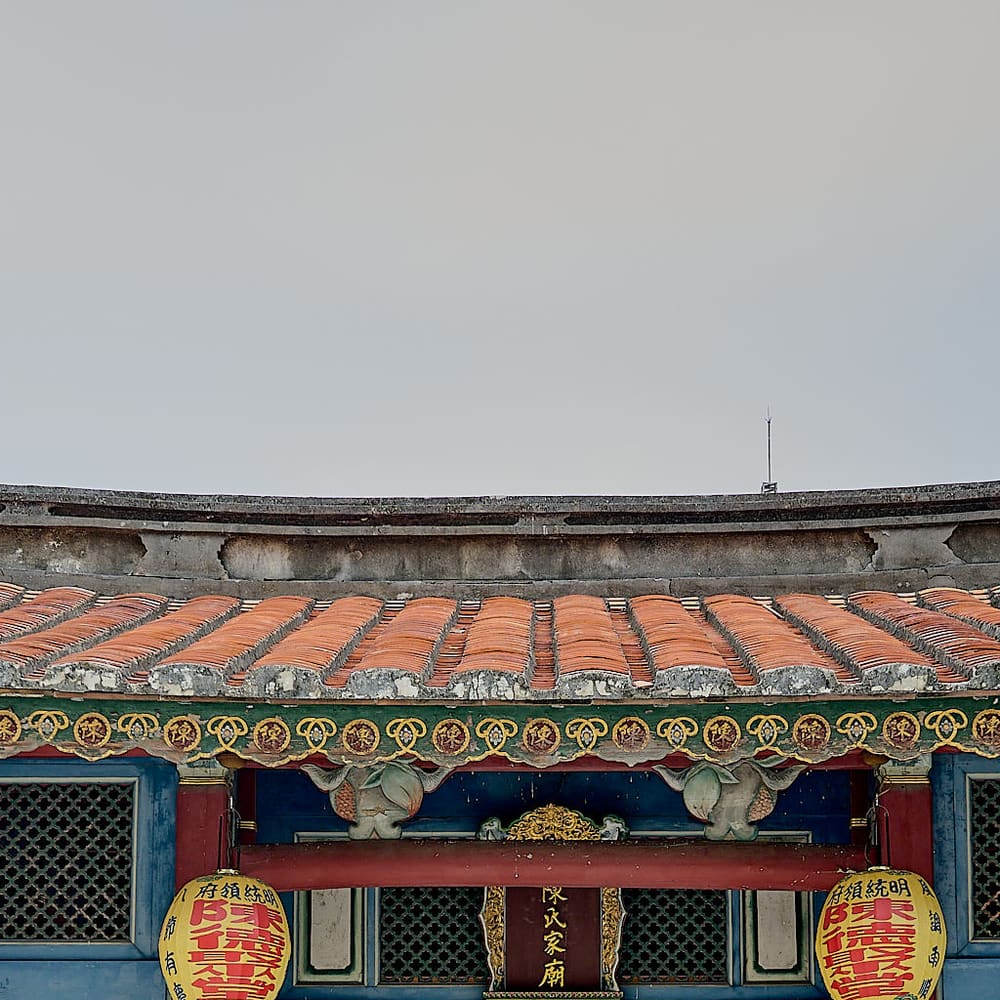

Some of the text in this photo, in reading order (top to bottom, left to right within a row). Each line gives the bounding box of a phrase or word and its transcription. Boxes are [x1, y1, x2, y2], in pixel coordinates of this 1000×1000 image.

[79, 717, 105, 743] 陳
[168, 722, 196, 746] 陳
[257, 722, 285, 748] 陳
[346, 723, 375, 749] 陳
[437, 722, 465, 749] 陳
[528, 722, 556, 749] 陳
[616, 722, 645, 748] 陳
[709, 720, 737, 746] 陳
[799, 719, 826, 745] 陳
[888, 716, 915, 743] 陳
[978, 713, 1000, 741] 陳
[195, 882, 279, 908] 明統領府
[827, 878, 912, 905] 明統領府
[538, 886, 569, 988] 陳氏家廟
